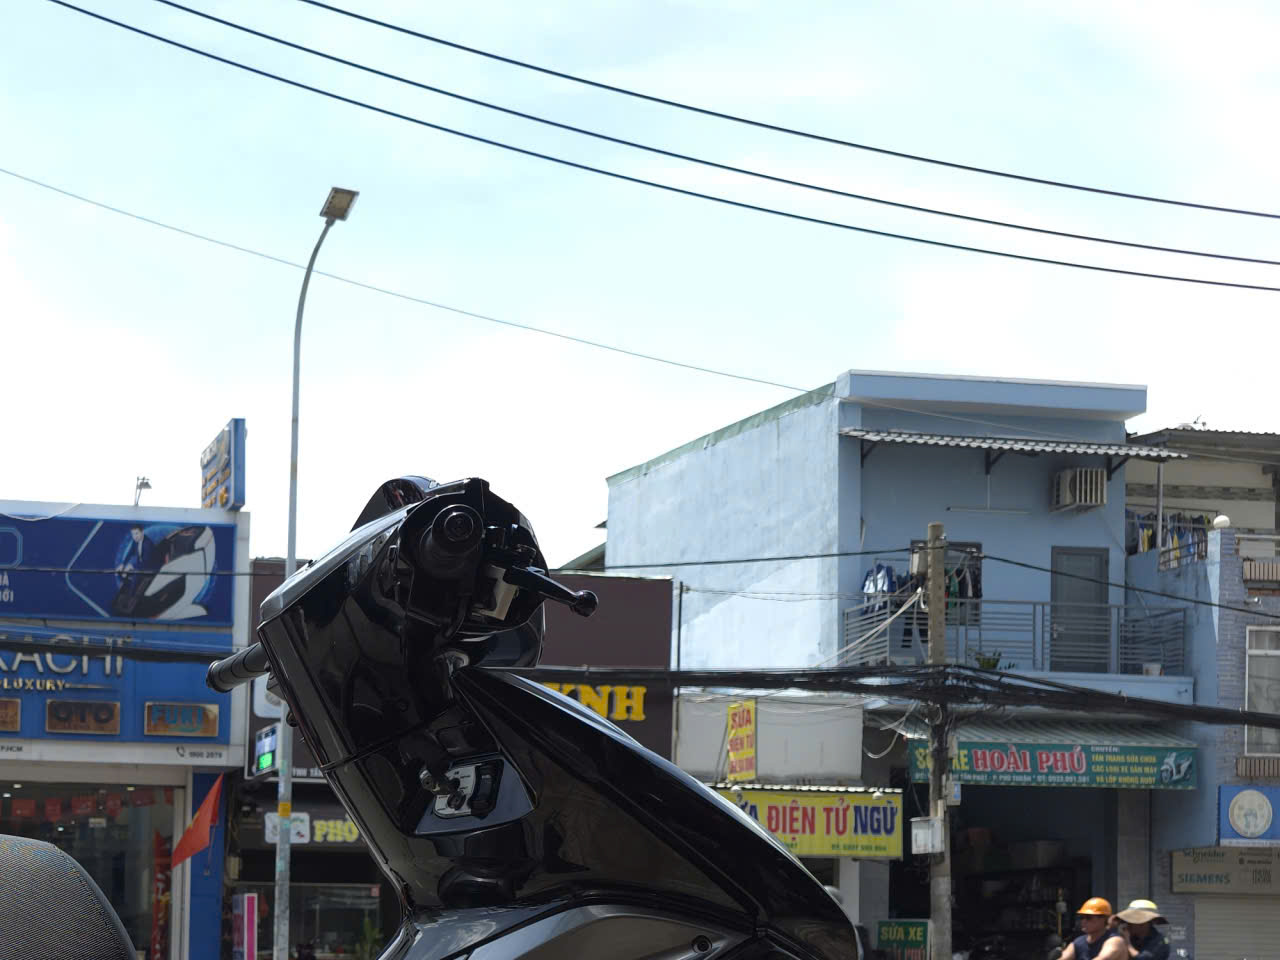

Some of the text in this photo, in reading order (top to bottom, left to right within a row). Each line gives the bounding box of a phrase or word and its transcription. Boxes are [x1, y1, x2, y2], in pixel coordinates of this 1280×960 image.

[3, 677, 66, 691] LUXURY
[971, 743, 1033, 772] HOÀI
[1036, 743, 1087, 775] PHÚ
[766, 799, 816, 841] ĐIỆN
[822, 796, 851, 836] TỬ
[907, 926, 924, 941] XE
